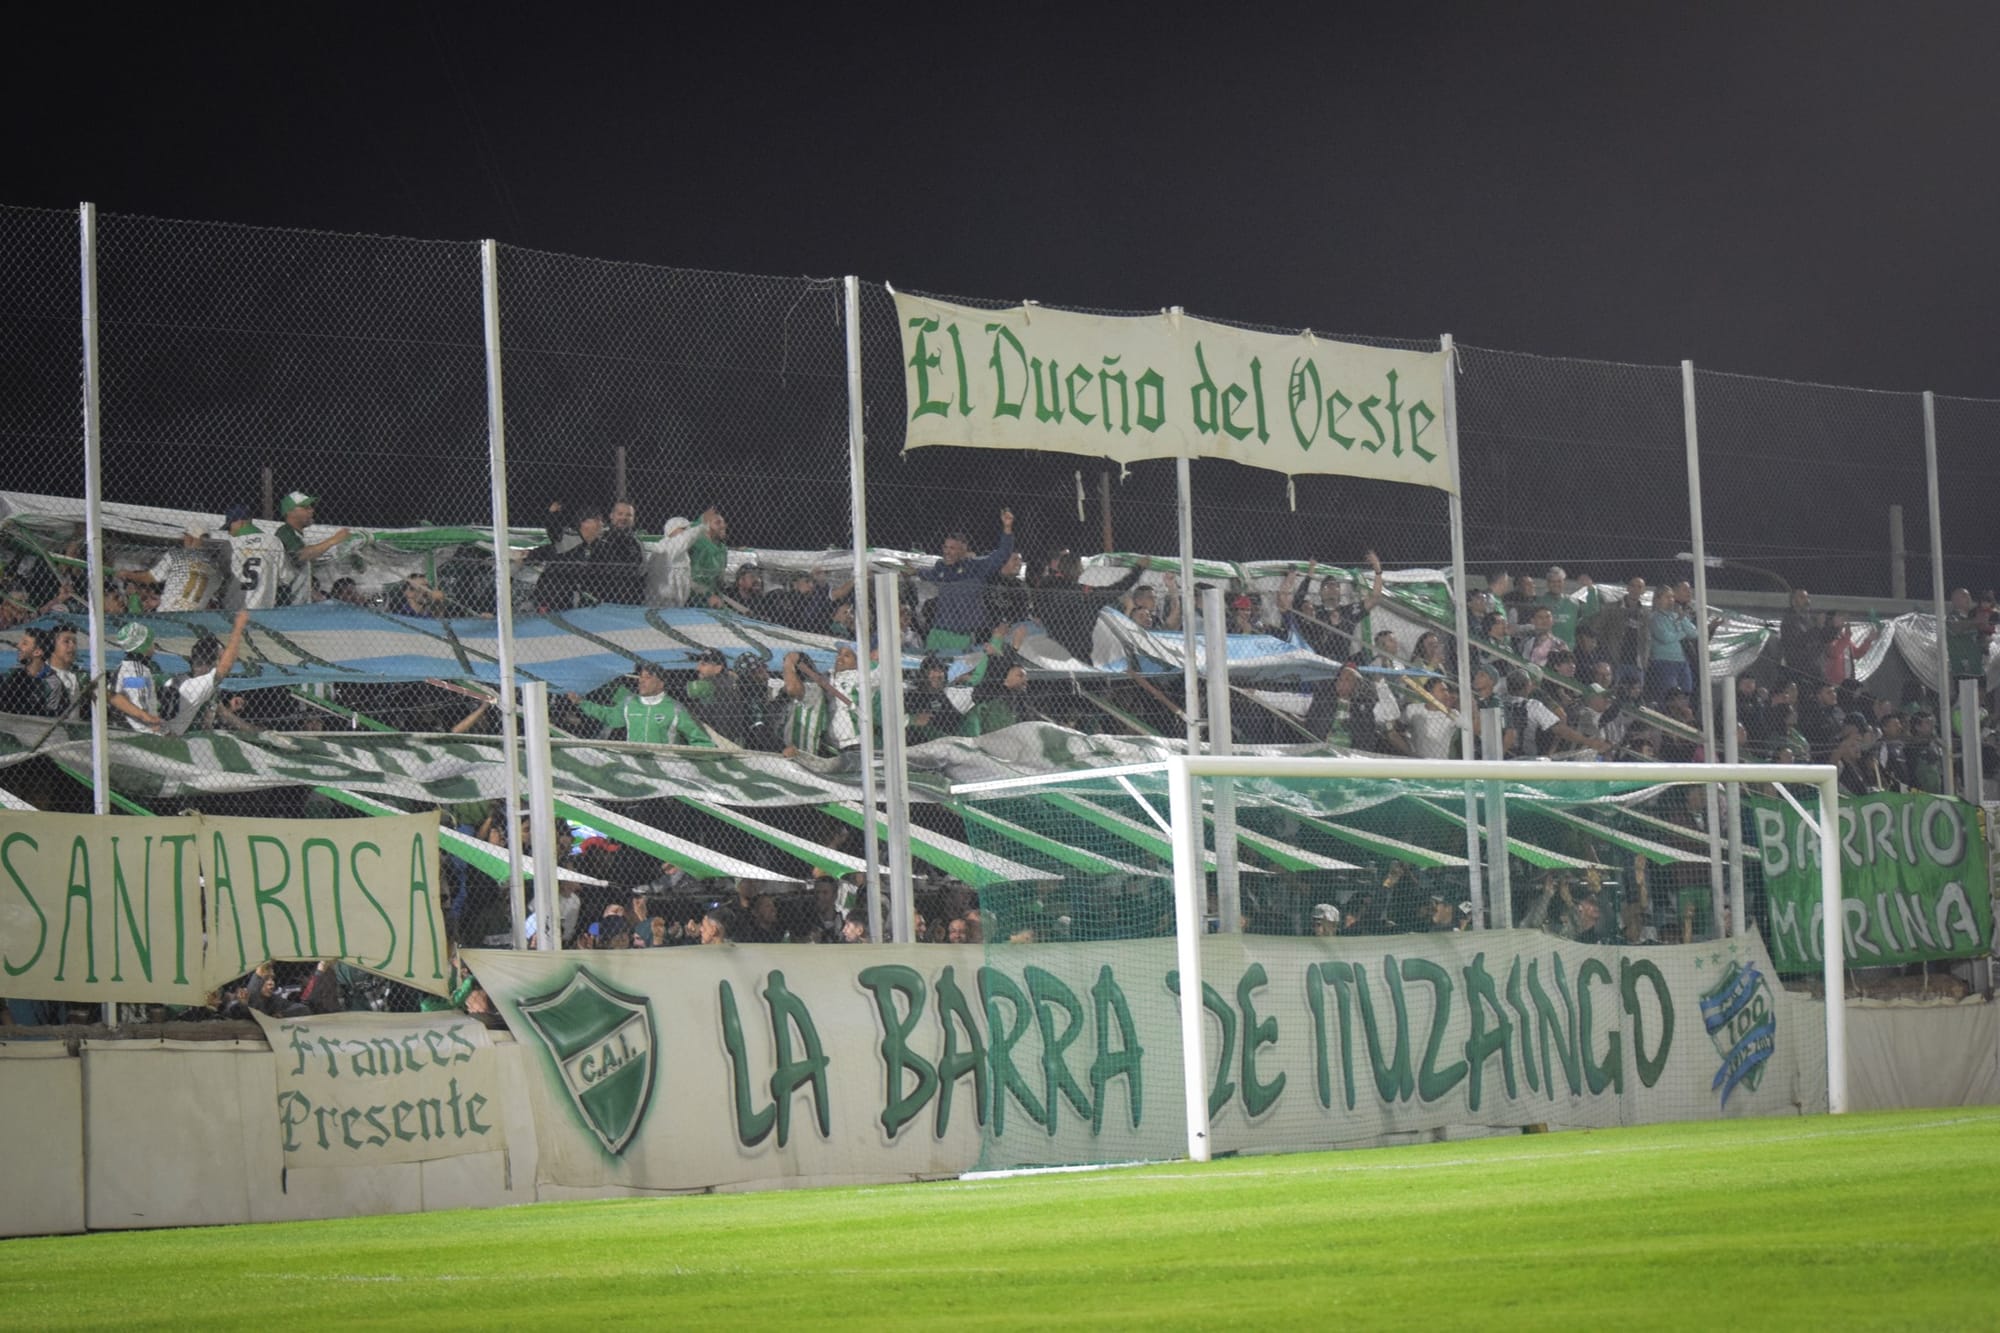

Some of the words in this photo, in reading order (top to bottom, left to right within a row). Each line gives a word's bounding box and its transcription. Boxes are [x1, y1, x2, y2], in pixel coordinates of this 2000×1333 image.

[909, 316, 974, 422] El
[986, 322, 1165, 435] Dueño
[1190, 341, 1270, 444] del
[1288, 357, 1437, 463] Oeste
[240, 557, 262, 590] 5
[280, 1022, 477, 1079] Frances
[1727, 994, 1764, 1045] 100
[719, 969, 830, 1148] LA
[858, 964, 1145, 1139] BARRA
[1165, 962, 1286, 1117] DE
[279, 1077, 493, 1152] Presente
